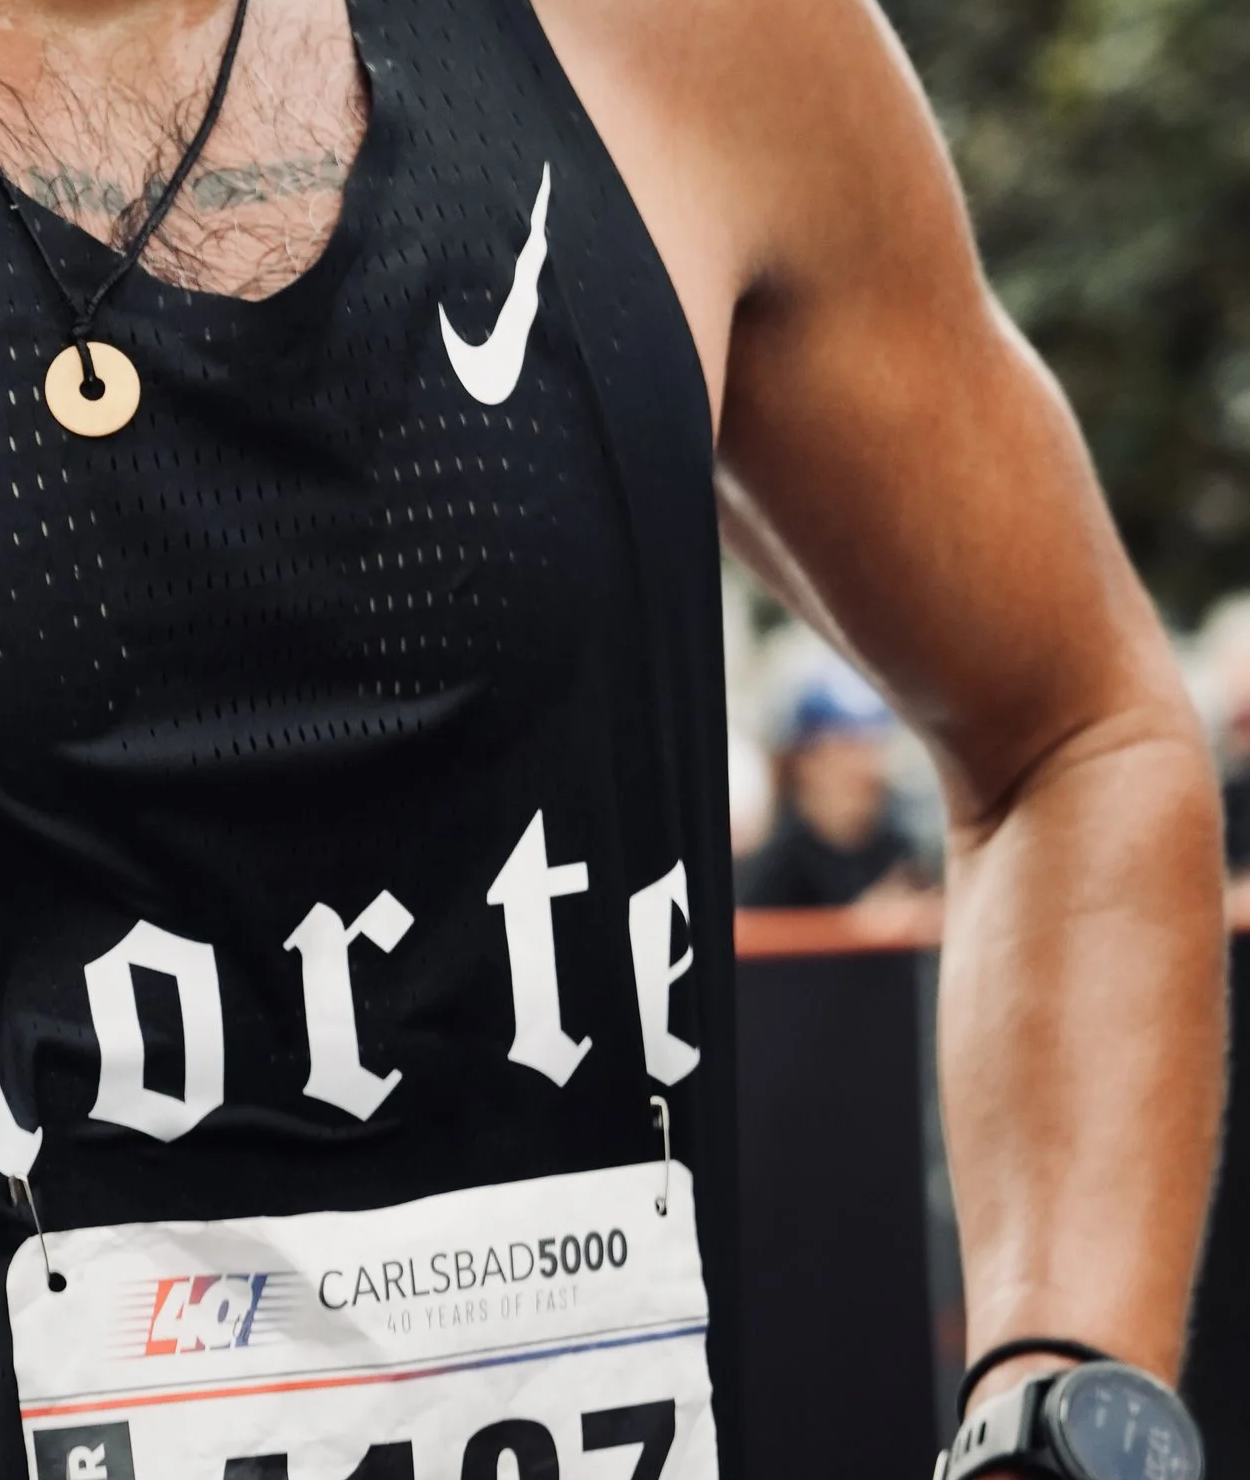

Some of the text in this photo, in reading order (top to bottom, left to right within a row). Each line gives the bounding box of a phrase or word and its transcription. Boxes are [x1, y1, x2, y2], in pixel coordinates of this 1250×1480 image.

[318, 1227, 628, 1311] CARLSBAD5000
[387, 1284, 579, 1334] 40 YEARS OF FAST
